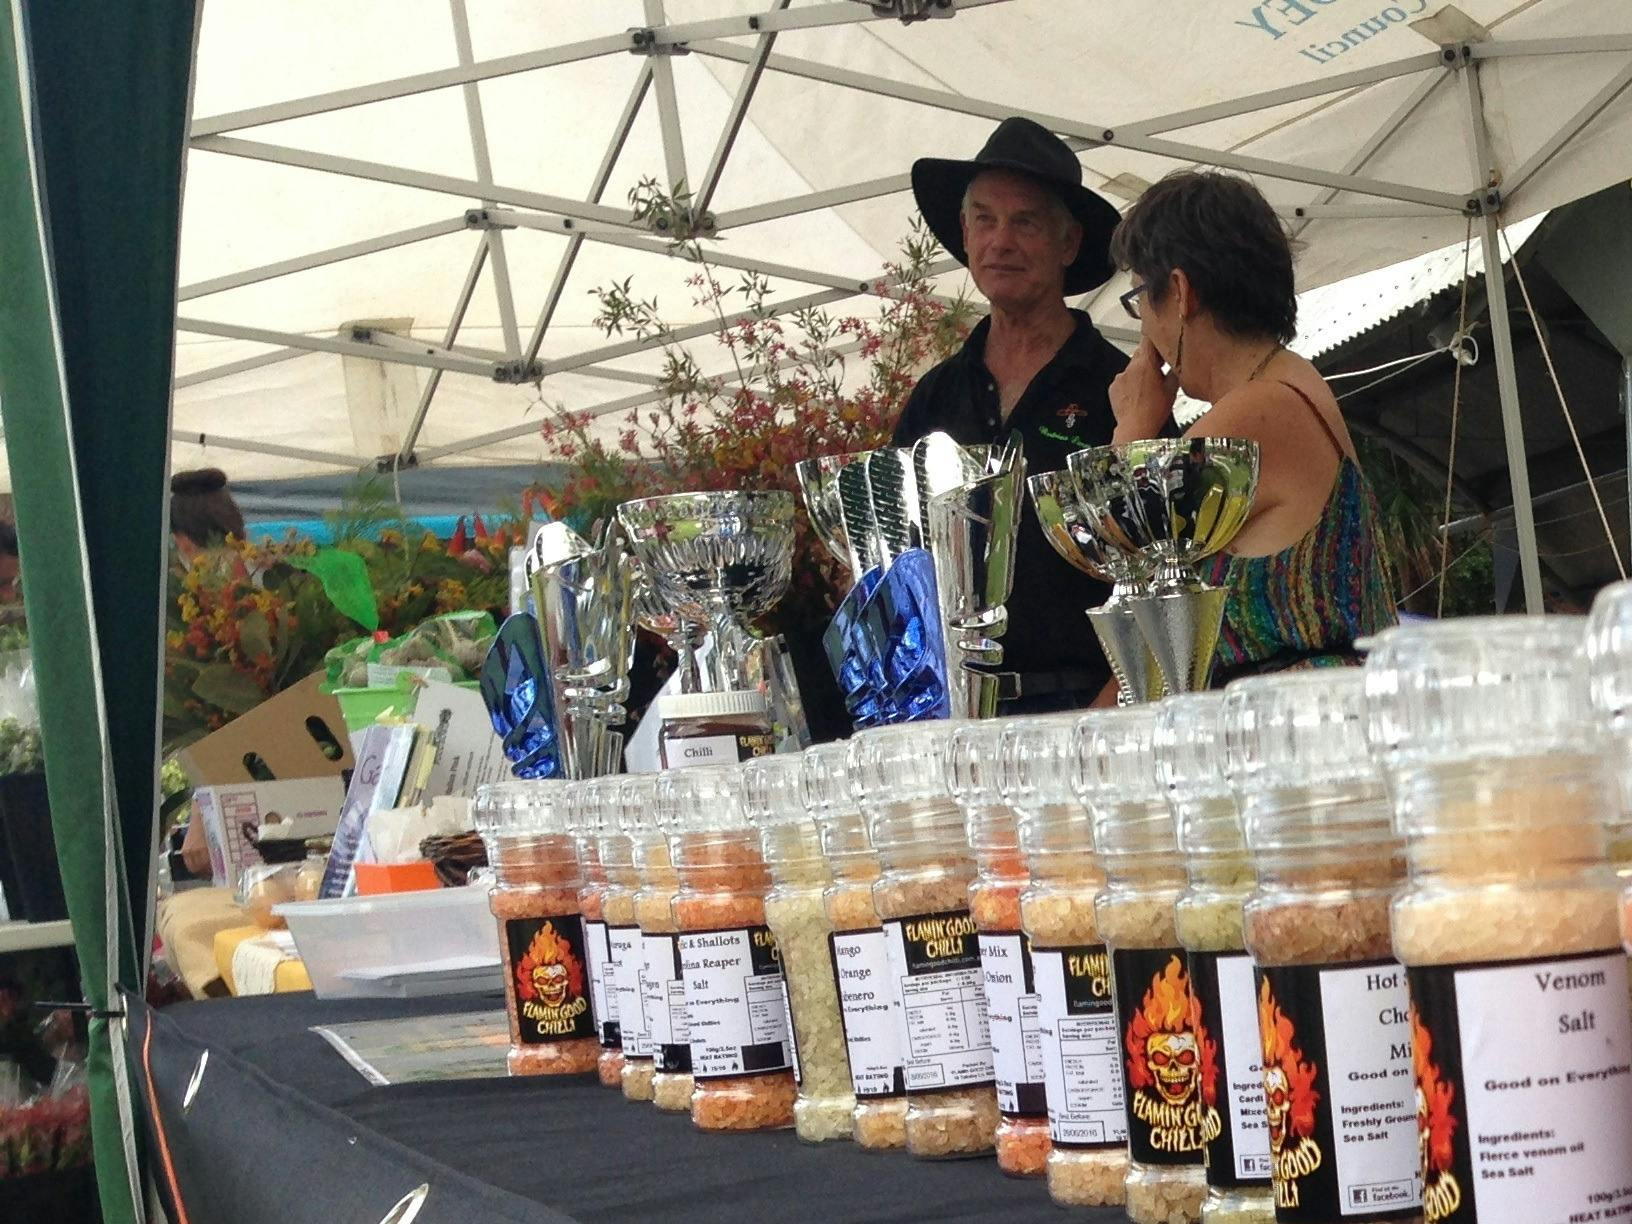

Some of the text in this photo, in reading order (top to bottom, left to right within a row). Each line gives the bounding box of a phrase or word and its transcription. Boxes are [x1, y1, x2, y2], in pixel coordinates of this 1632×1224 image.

[684, 747, 713, 758] Chilli
[697, 935, 741, 948] Shallots
[988, 945, 1008, 958] Mix
[703, 957, 741, 969] Reaper
[693, 979, 709, 990] Salt
[1366, 972, 1398, 991] Hot
[1534, 971, 1607, 992] Venom
[1558, 1009, 1596, 1034] Salt
[1348, 1067, 1409, 1081] Good on
[1484, 1076, 1532, 1091] Good
[1537, 1077, 1560, 1087] on
[1341, 1100, 1405, 1114] Ingredients:
[1241, 1121, 1258, 1130] Sea
[1342, 1117, 1382, 1128] Freshly
[1343, 1131, 1388, 1143] Sea Salt
[1478, 1129, 1556, 1145] Ingredients:
[1281, 1134, 1322, 1180] GOOD
[1480, 1151, 1519, 1162] Fierce
[1523, 1146, 1567, 1158] venom
[1481, 1166, 1535, 1179] Sea Salt
[1568, 1211, 1600, 1224] HEAT
